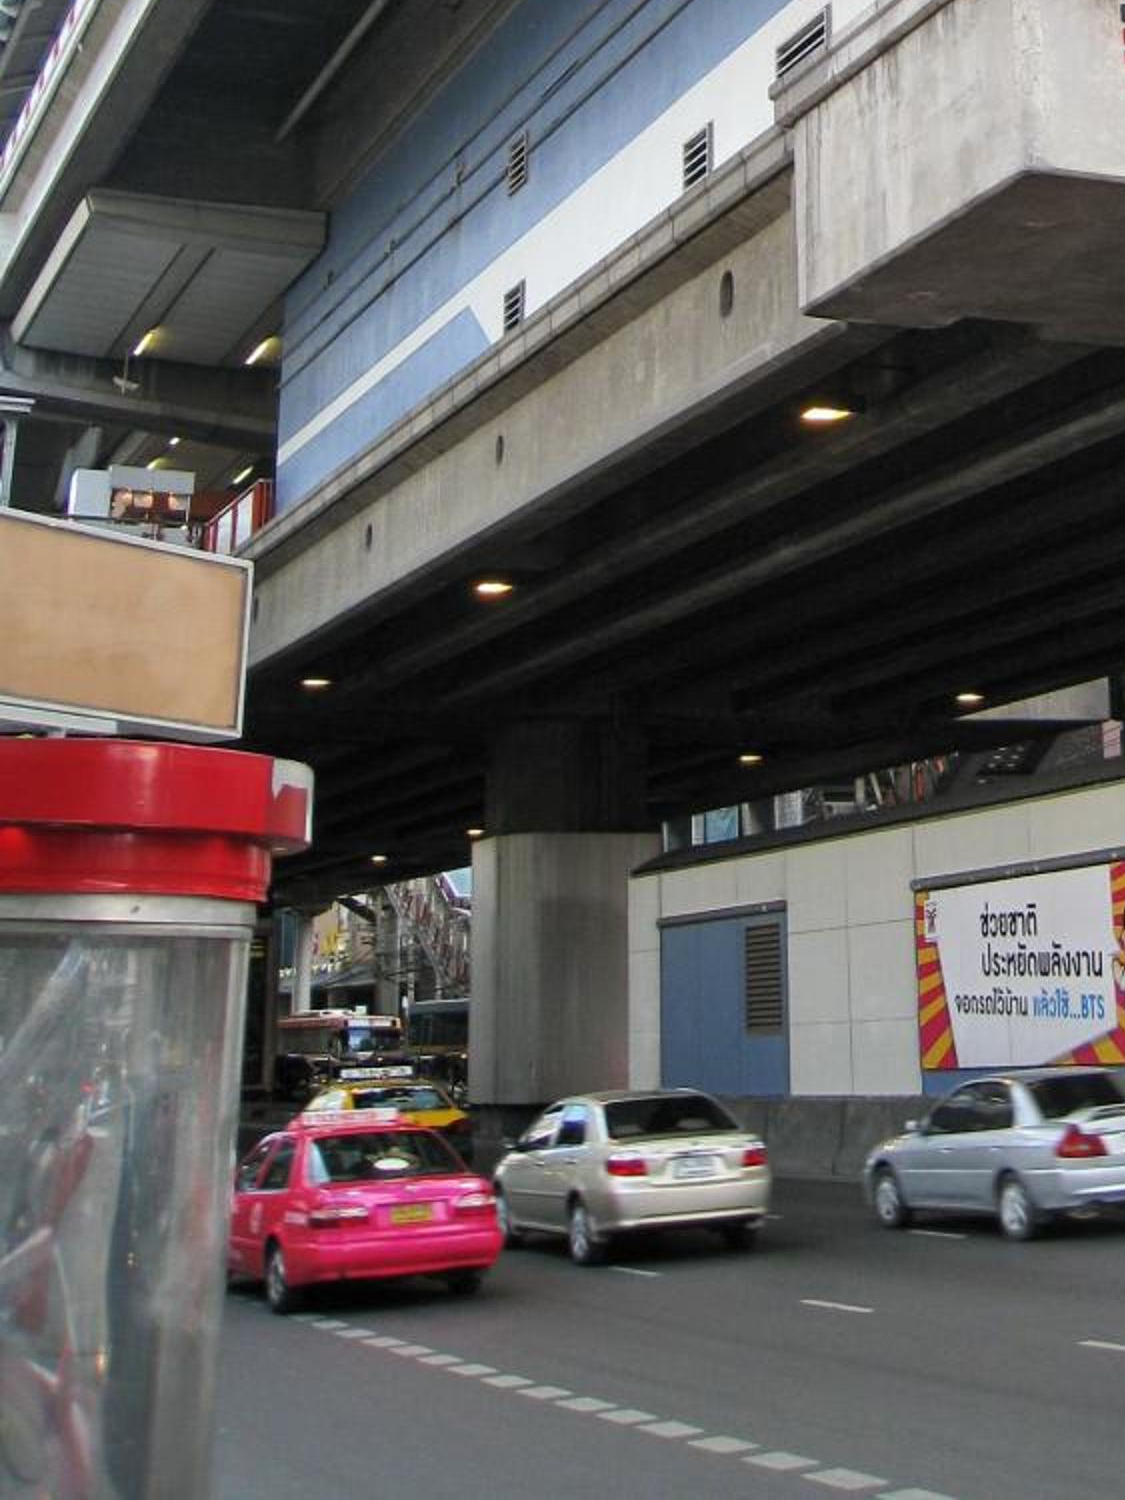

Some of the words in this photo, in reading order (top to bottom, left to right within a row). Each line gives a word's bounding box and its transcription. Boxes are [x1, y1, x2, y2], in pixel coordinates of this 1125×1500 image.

[979, 902, 1038, 937] ช่วยชาติ
[981, 941, 1104, 977] ประหยัดพลังงาน
